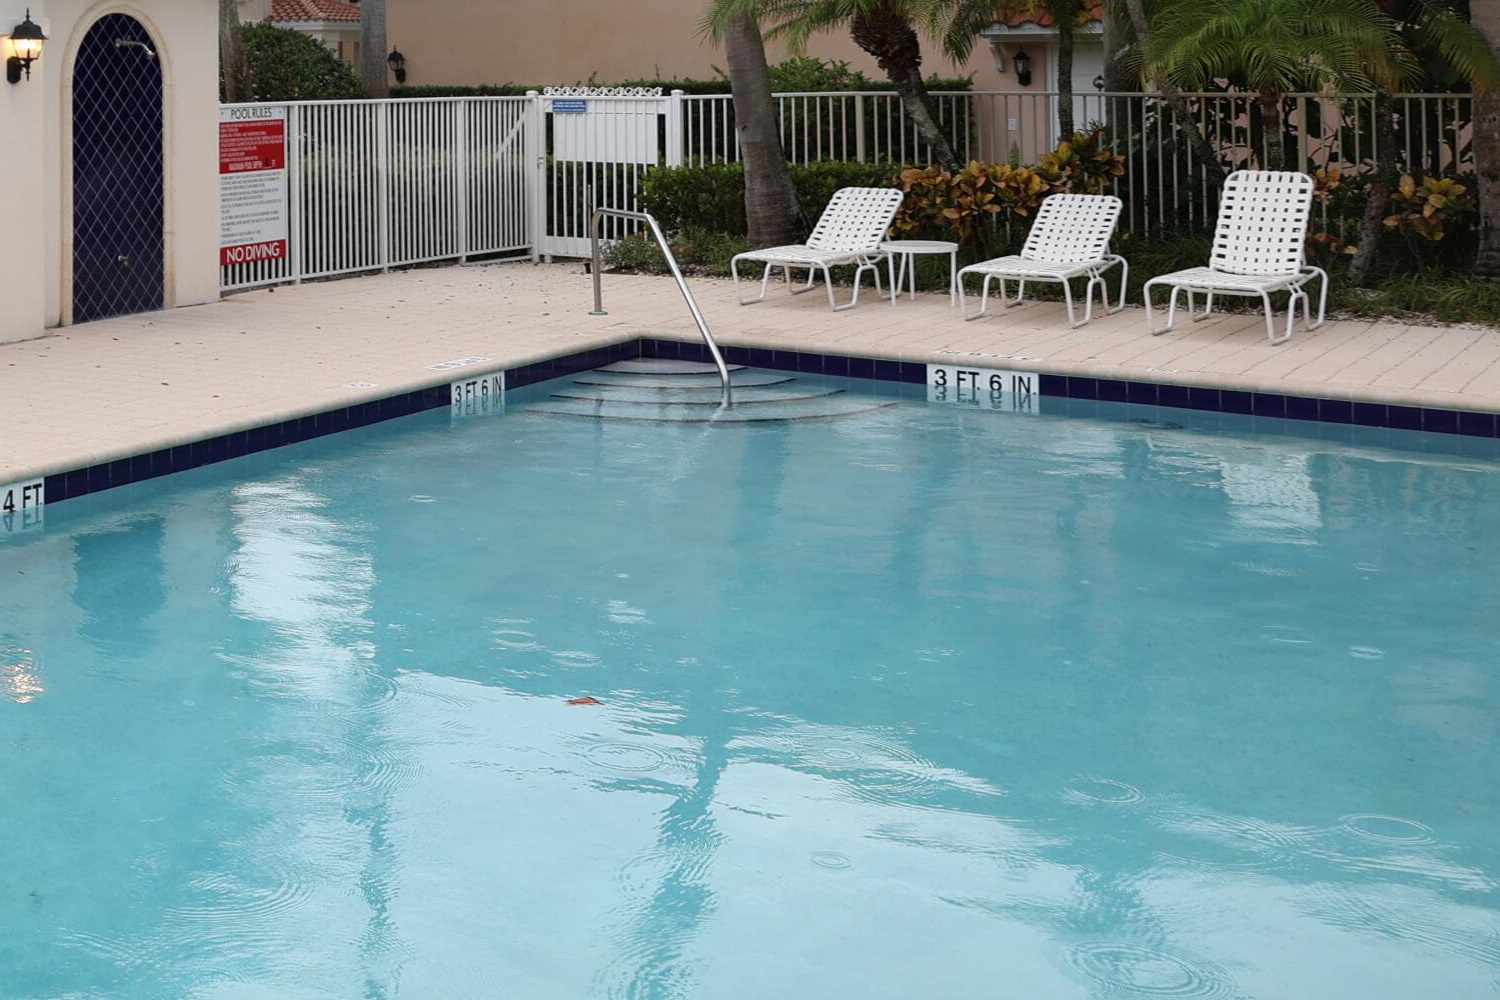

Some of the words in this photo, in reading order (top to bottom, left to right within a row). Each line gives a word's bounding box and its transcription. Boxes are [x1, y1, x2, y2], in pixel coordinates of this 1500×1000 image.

[231, 107, 251, 120] POOL
[252, 106, 273, 118] RULES
[226, 248, 244, 263] NO
[245, 242, 280, 261] DIVING
[454, 384, 462, 403] 3
[481, 379, 488, 396] 6
[934, 368, 947, 386] 3
[956, 369, 980, 391] FT.
[989, 373, 1002, 391] 6
[1012, 374, 1037, 396] IN.
[3, 489, 16, 512] 4
